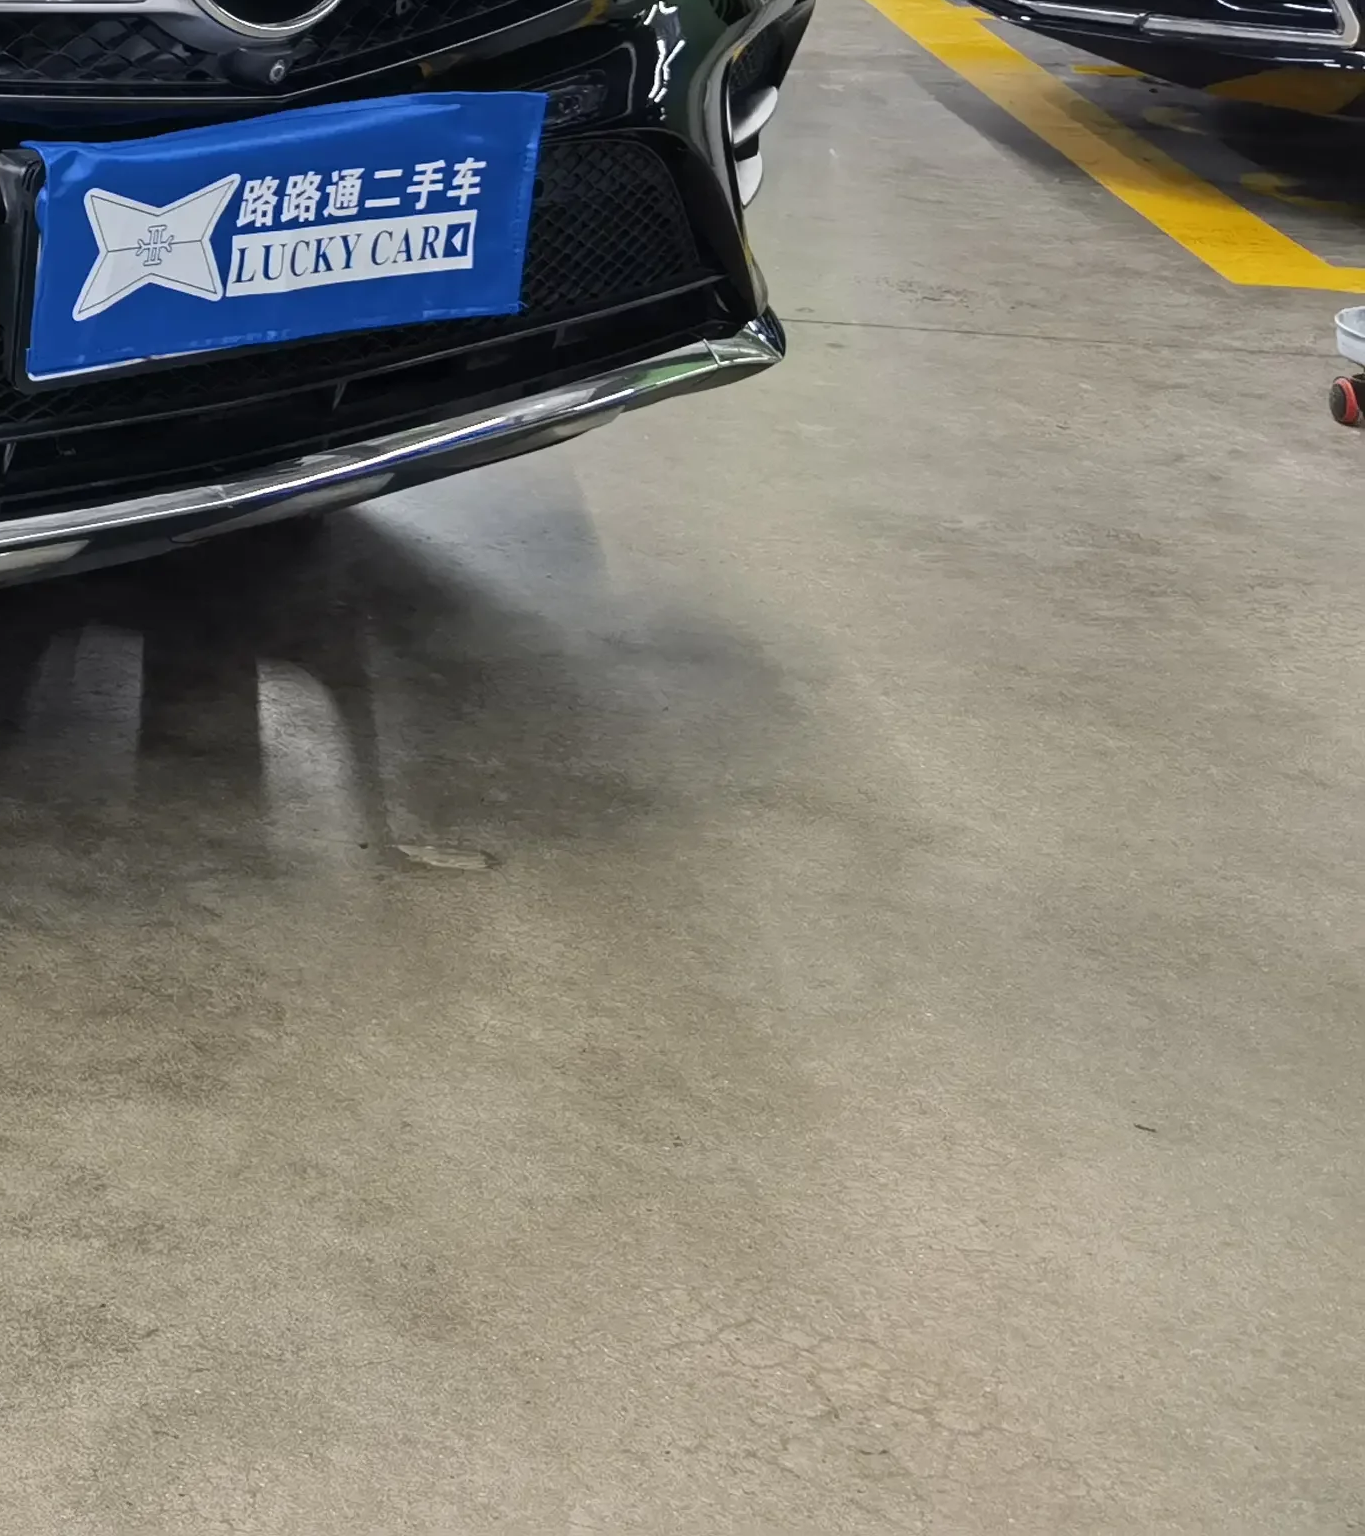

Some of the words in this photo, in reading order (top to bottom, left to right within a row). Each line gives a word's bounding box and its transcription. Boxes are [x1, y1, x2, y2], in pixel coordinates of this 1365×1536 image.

[236, 157, 487, 228] 路路通二手车
[231, 232, 362, 284] LUCKY
[370, 224, 441, 266] CAR
